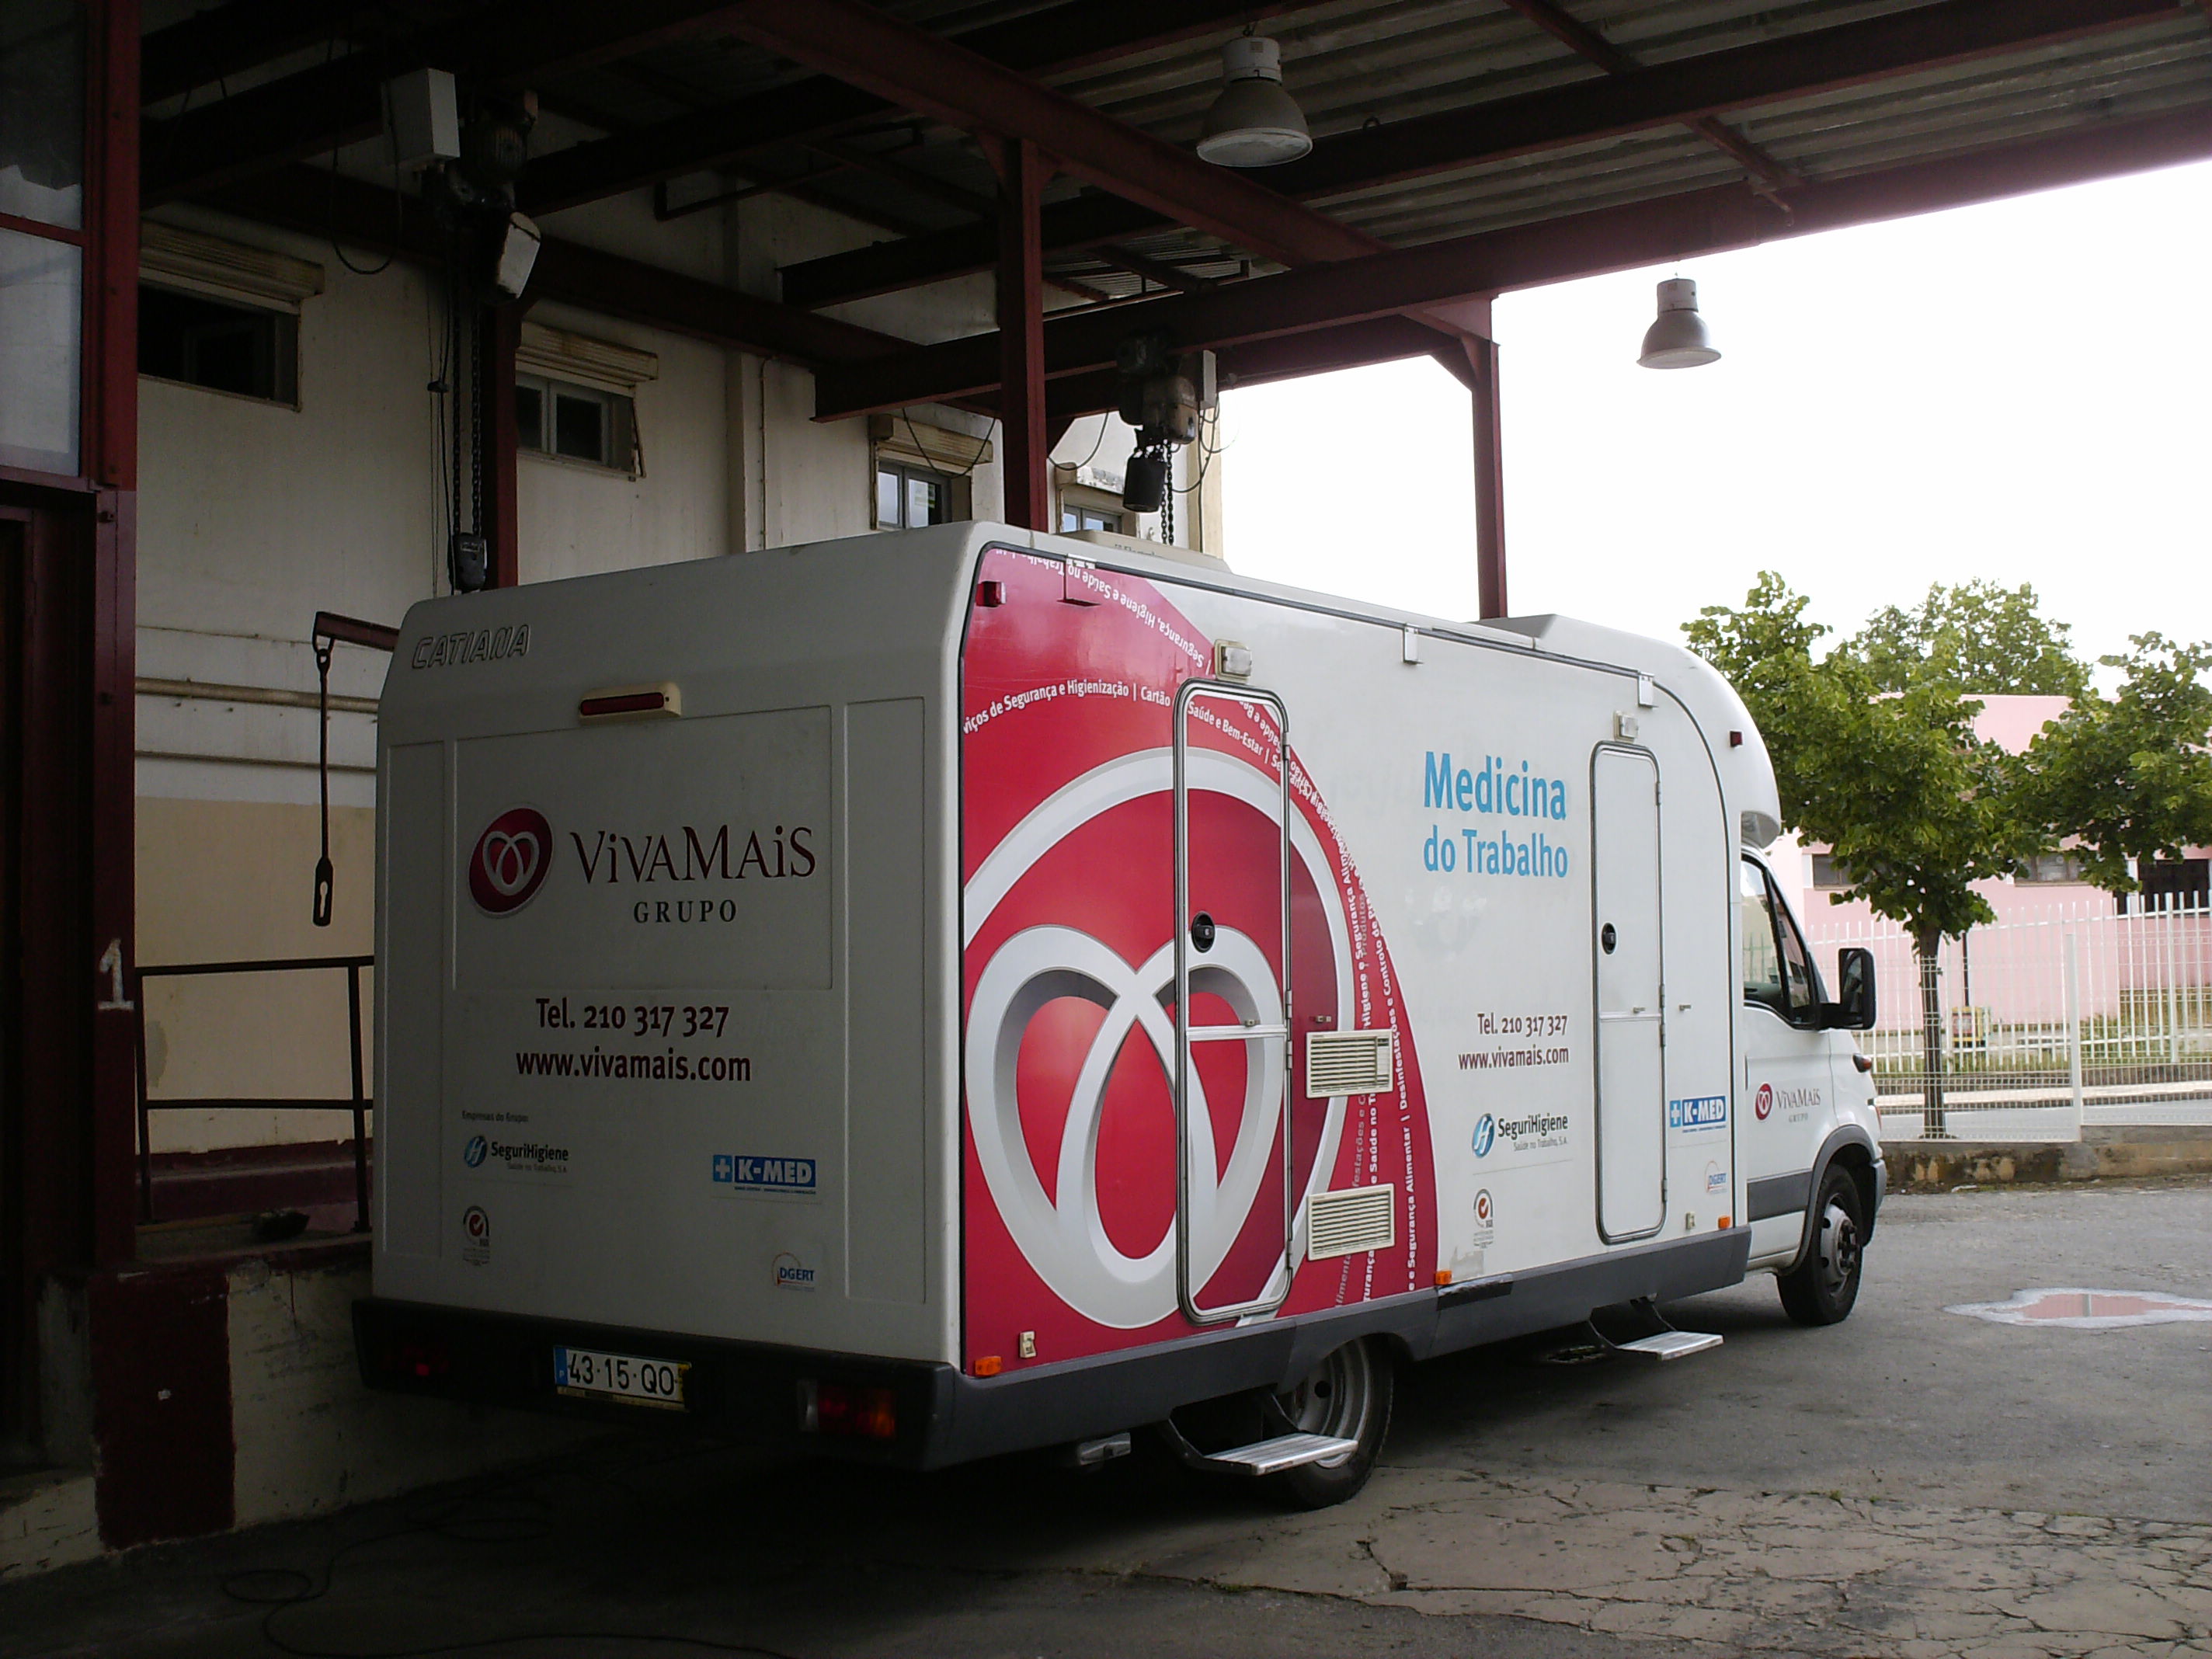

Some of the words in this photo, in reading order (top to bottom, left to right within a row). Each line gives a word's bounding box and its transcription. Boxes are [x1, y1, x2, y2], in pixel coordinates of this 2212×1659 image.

[1068, 565, 1080, 579] no
[1082, 571, 1111, 600] Saúde
[1112, 589, 1119, 600] e
[1120, 593, 1156, 628] Higiene
[412, 624, 530, 669] CATIANA
[990, 701, 1003, 718] de
[1004, 685, 1057, 711] Segurança
[1059, 684, 1066, 695] e
[1067, 679, 1129, 698] Higienização
[1140, 686, 1171, 707] Cartão
[1188, 701, 1215, 725] Saúde
[1216, 718, 1221, 729] e
[1223, 718, 1263, 756] Bem-Estar
[1424, 751, 1566, 820] Medicina
[1424, 825, 1456, 872] do
[1462, 829, 1567, 878] Trabalho
[634, 899, 737, 923] GRUPO
[1346, 887, 1363, 960] Segurança
[1372, 920, 1380, 937] de
[98, 938, 134, 1010] 1
[1376, 940, 1392, 996] Controlo
[536, 997, 576, 1028] Tel.
[584, 1006, 626, 1029] 210
[634, 1006, 675, 1037] 317
[683, 1007, 729, 1038] 327
[1387, 997, 1393, 1007] e
[1477, 1012, 1498, 1035] Tel.
[1501, 1017, 1522, 1034] 210
[1525, 1016, 1544, 1038] 317
[1547, 1015, 1567, 1036] 327
[516, 1045, 750, 1081] www.vivamais.com
[1388, 1007, 1408, 1110] Desinfestações
[1459, 1044, 1569, 1069] www.vivamais.com
[1369, 1107, 1377, 1125] no
[1497, 1113, 1568, 1140] SeguriHigiene
[1684, 1098, 1724, 1123] K-MED
[491, 1141, 569, 1163] SeguriHigiene
[1369, 1128, 1378, 1173] Saúde
[1403, 1127, 1414, 1193] Alimentar
[739, 1158, 812, 1184] K-MED
[1371, 1175, 1377, 1184] e
[1407, 1195, 1417, 1268] Segurança
[778, 1267, 814, 1282] DGERT
